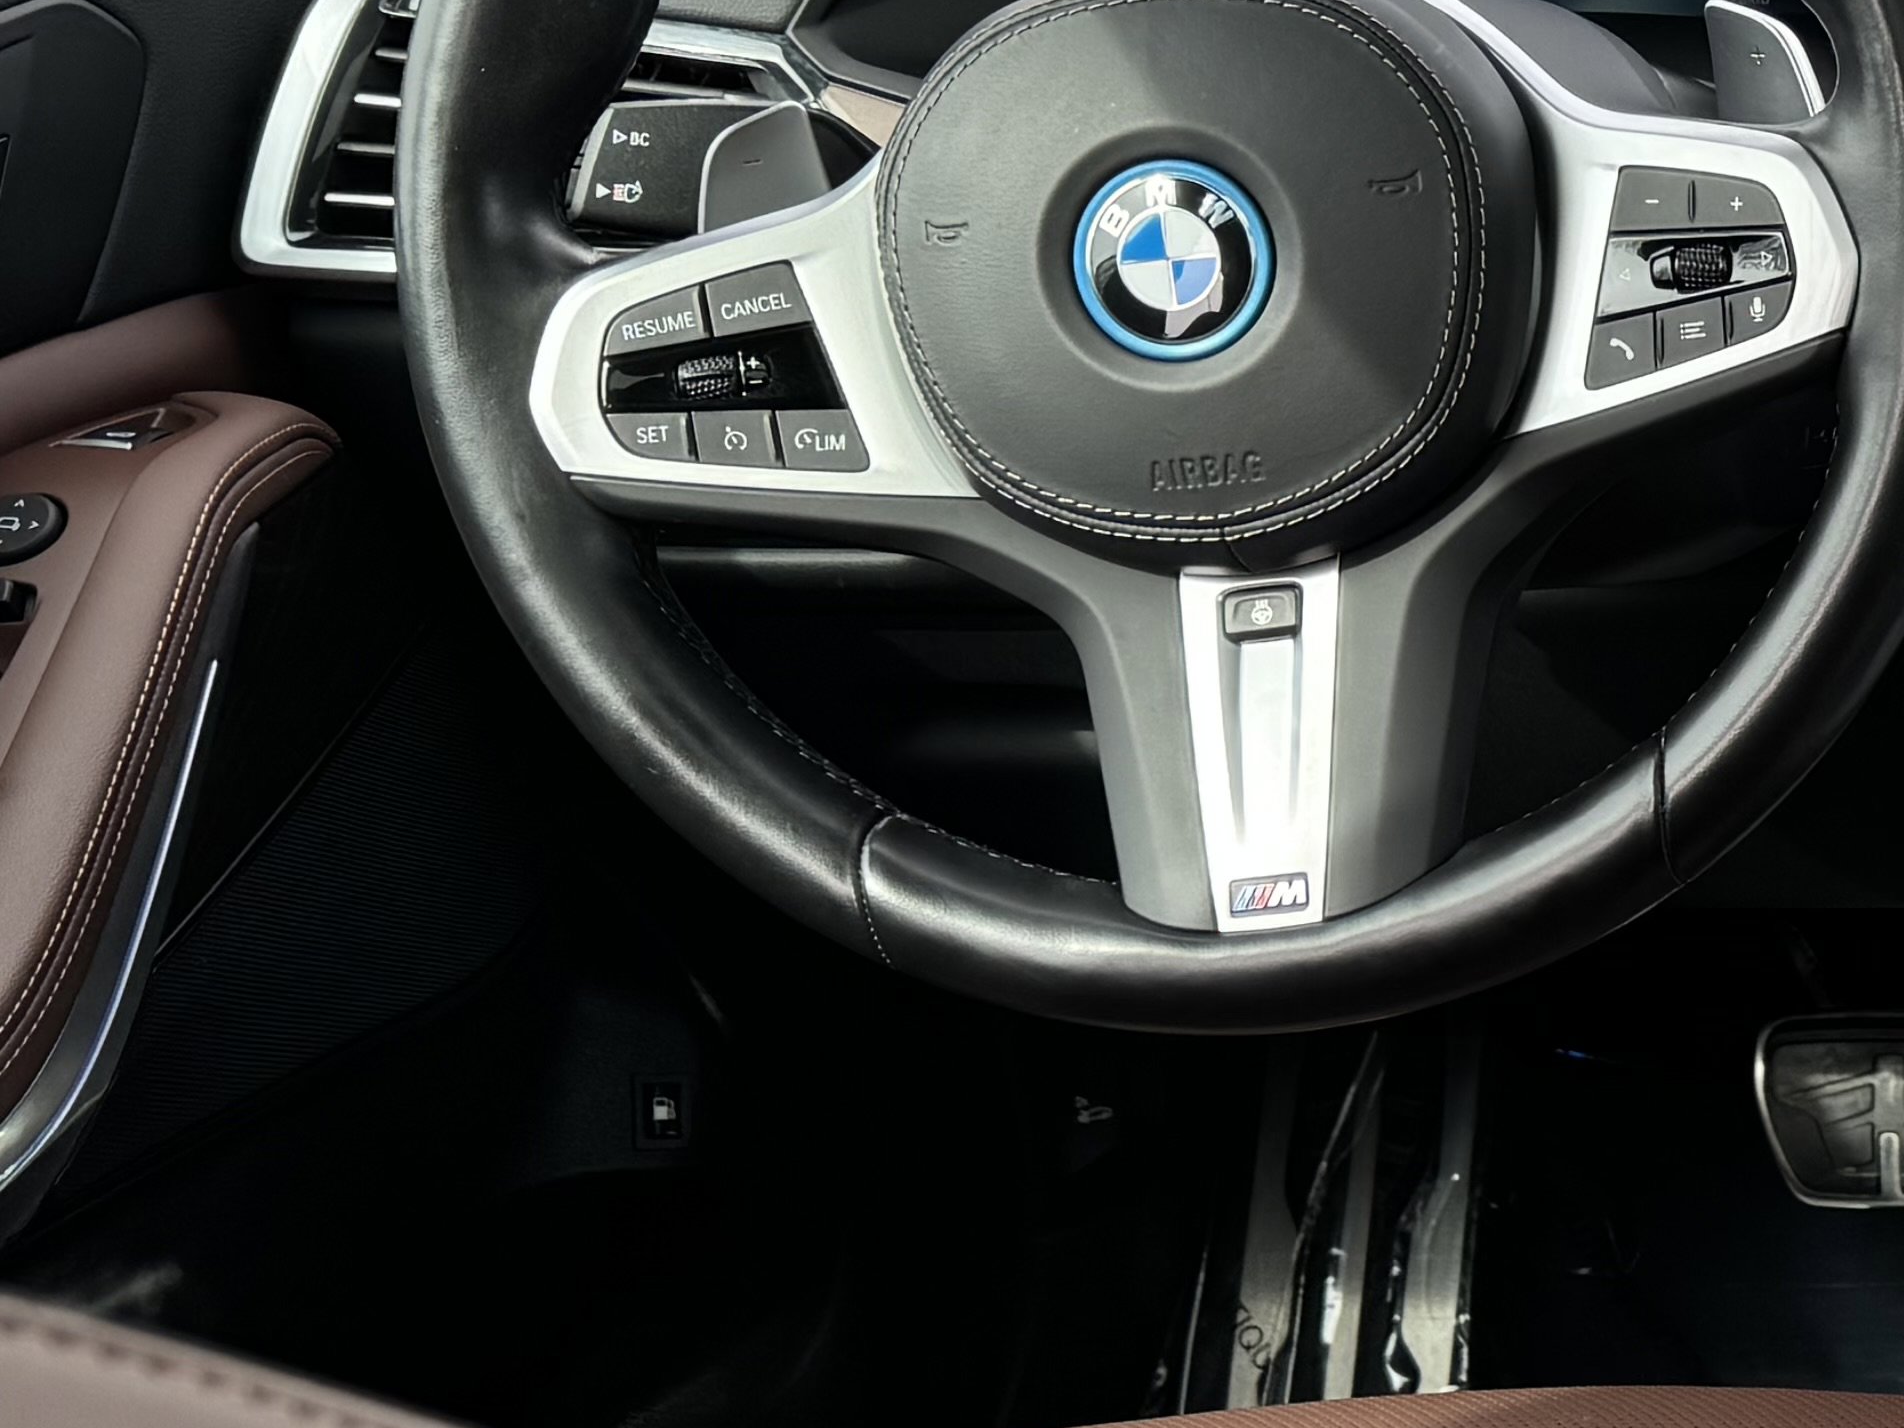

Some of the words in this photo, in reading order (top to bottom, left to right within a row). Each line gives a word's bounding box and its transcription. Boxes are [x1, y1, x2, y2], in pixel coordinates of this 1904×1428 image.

[1098, 175, 1235, 239] BMW
[720, 291, 793, 322] CANCEL
[621, 310, 696, 342] RESUME
[636, 425, 669, 445] SET
[814, 434, 847, 453] LIM
[1150, 449, 1267, 493] AIRBAG
